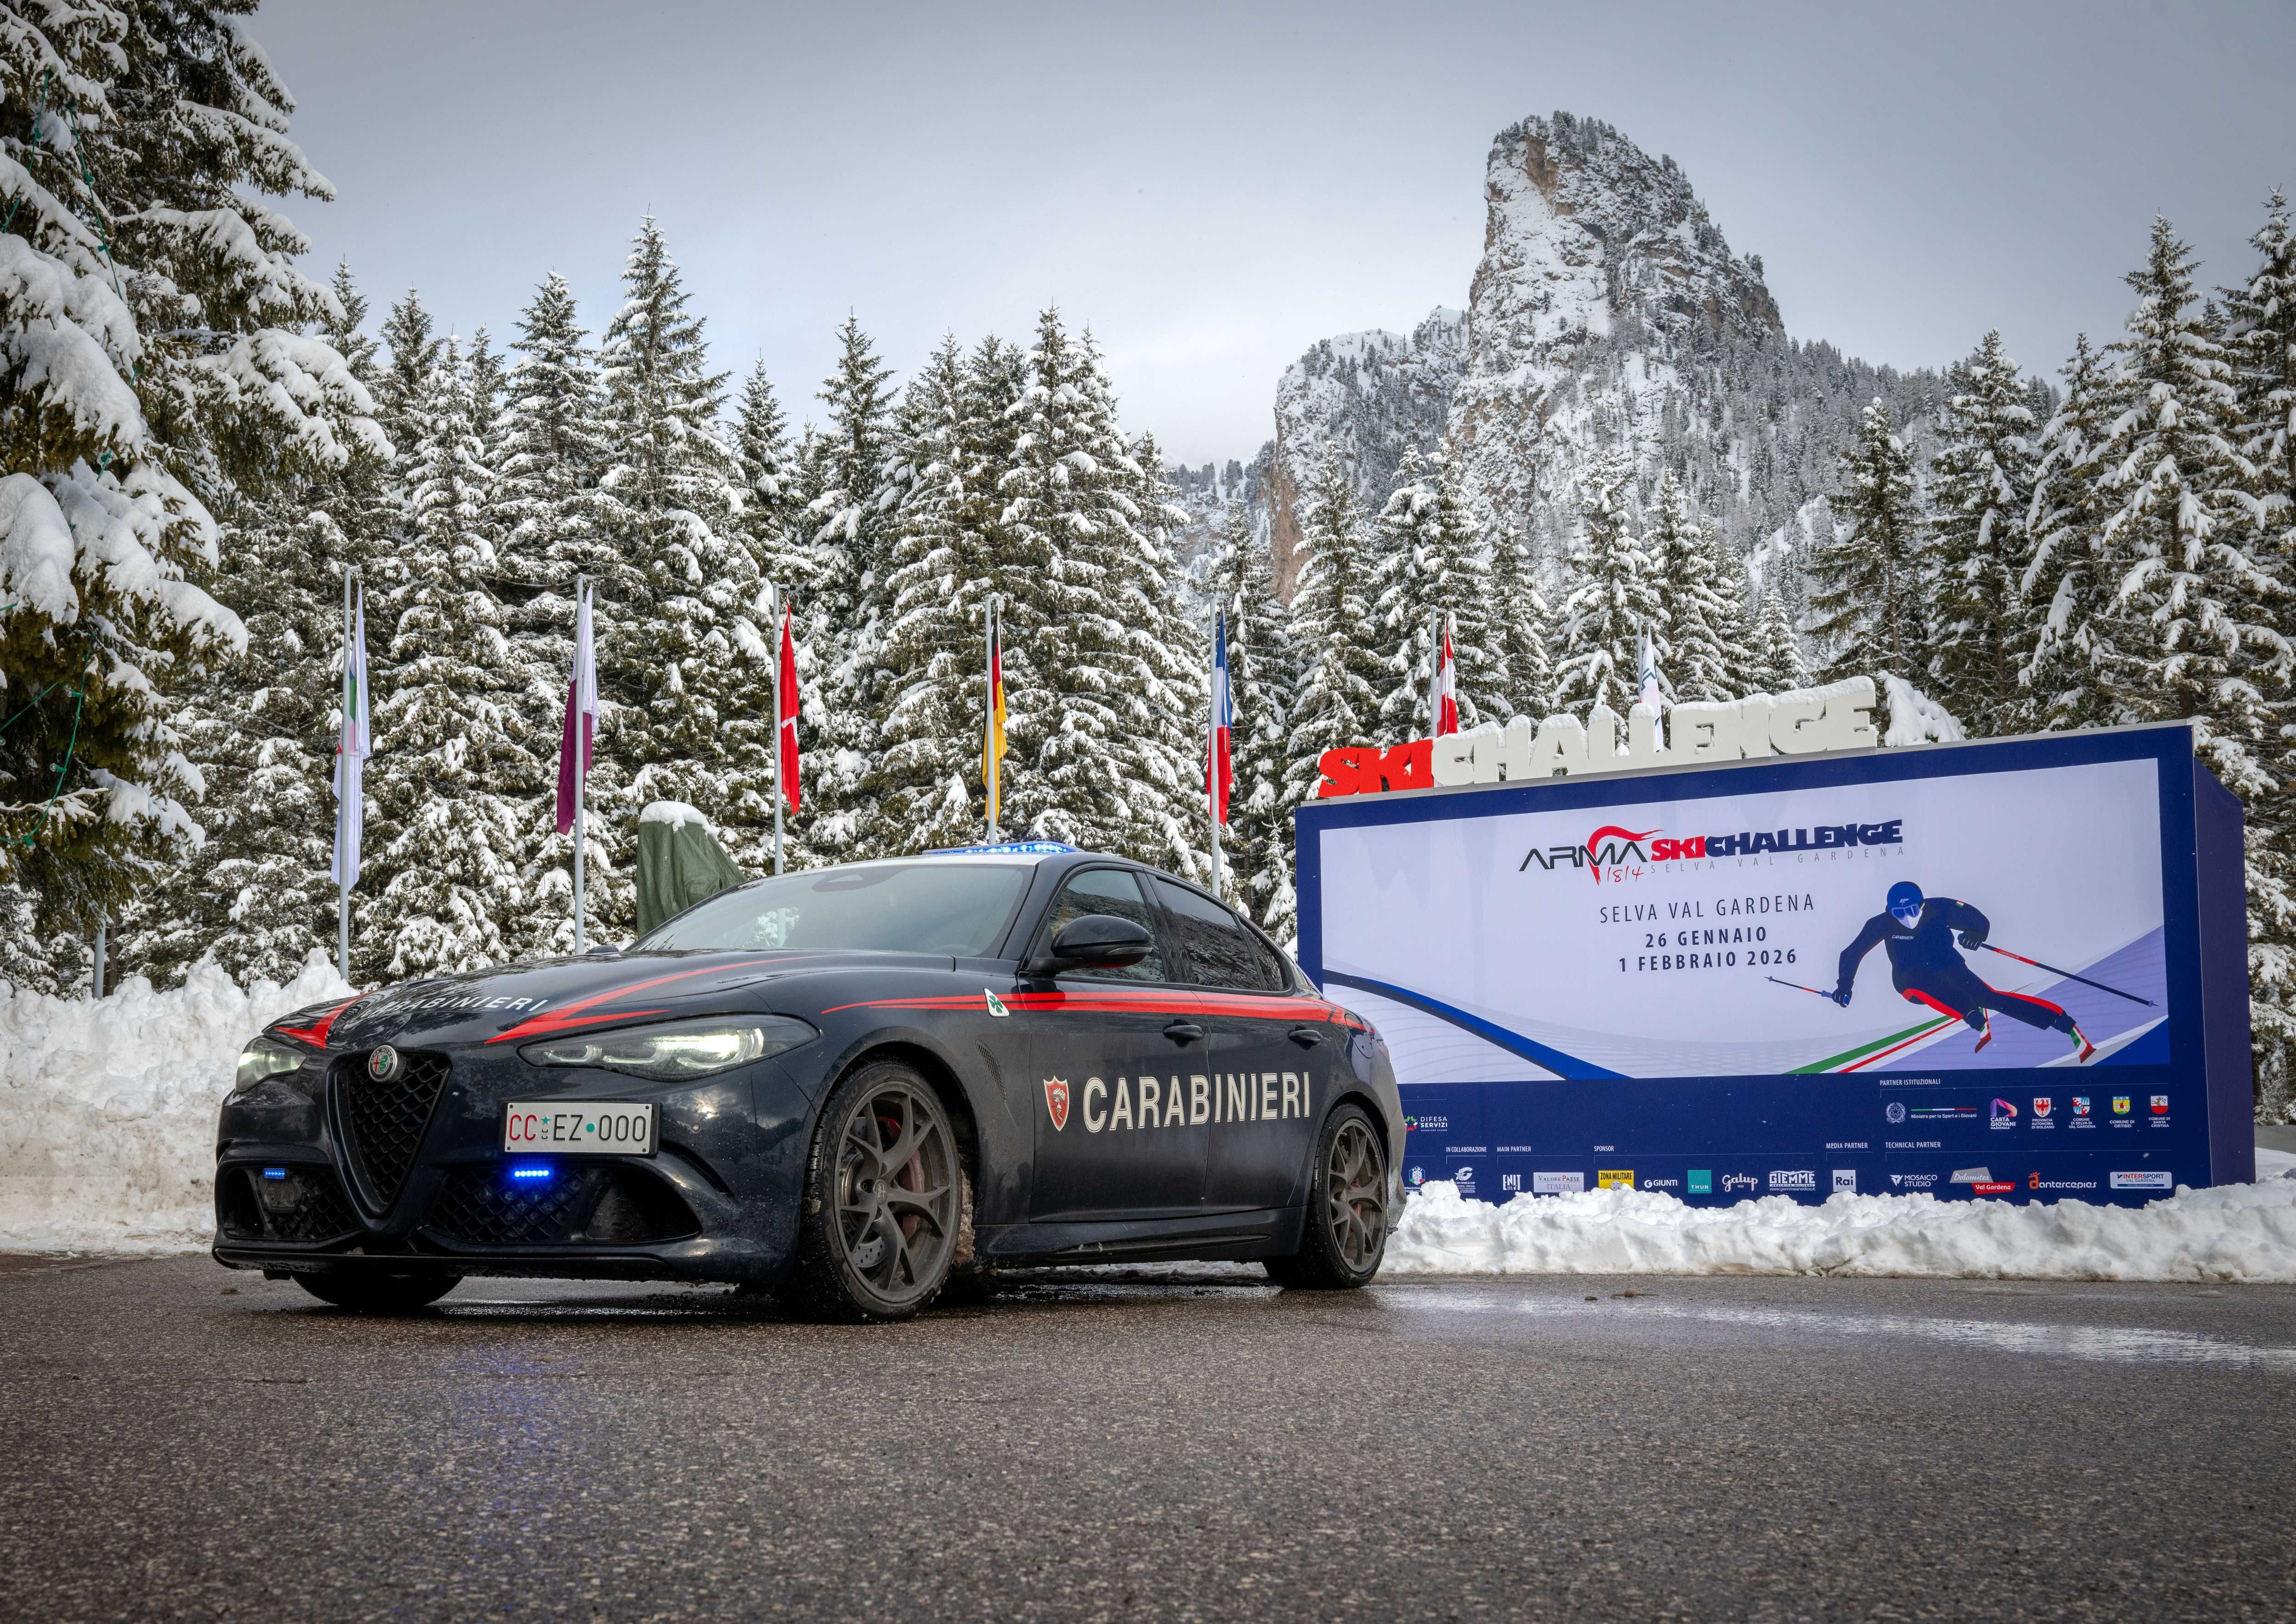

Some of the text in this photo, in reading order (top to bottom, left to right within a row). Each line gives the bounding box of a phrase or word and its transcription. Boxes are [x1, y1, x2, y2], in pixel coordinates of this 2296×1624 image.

[1519, 841, 1648, 872] ARMA
[1650, 846, 1903, 874] SELVA VAL GARDENA
[1606, 866, 1645, 884] 1814
[1600, 893, 1813, 923] SELVA VAL GARDENA
[1645, 926, 1766, 948] 26 GENNAIO
[1619, 949, 1796, 972] 1 FEBBRAIO 2026
[370, 997, 548, 1017] RABINIERI
[1083, 1072, 1310, 1133] CARABINIERI
[509, 1114, 647, 1142] CC EZ 000
[1722, 1173, 1758, 1192] Galup
[1769, 1173, 1815, 1184] GIEMME
[1835, 1176, 1853, 1186] Rai
[1953, 1173, 1989, 1181] Dolomites
